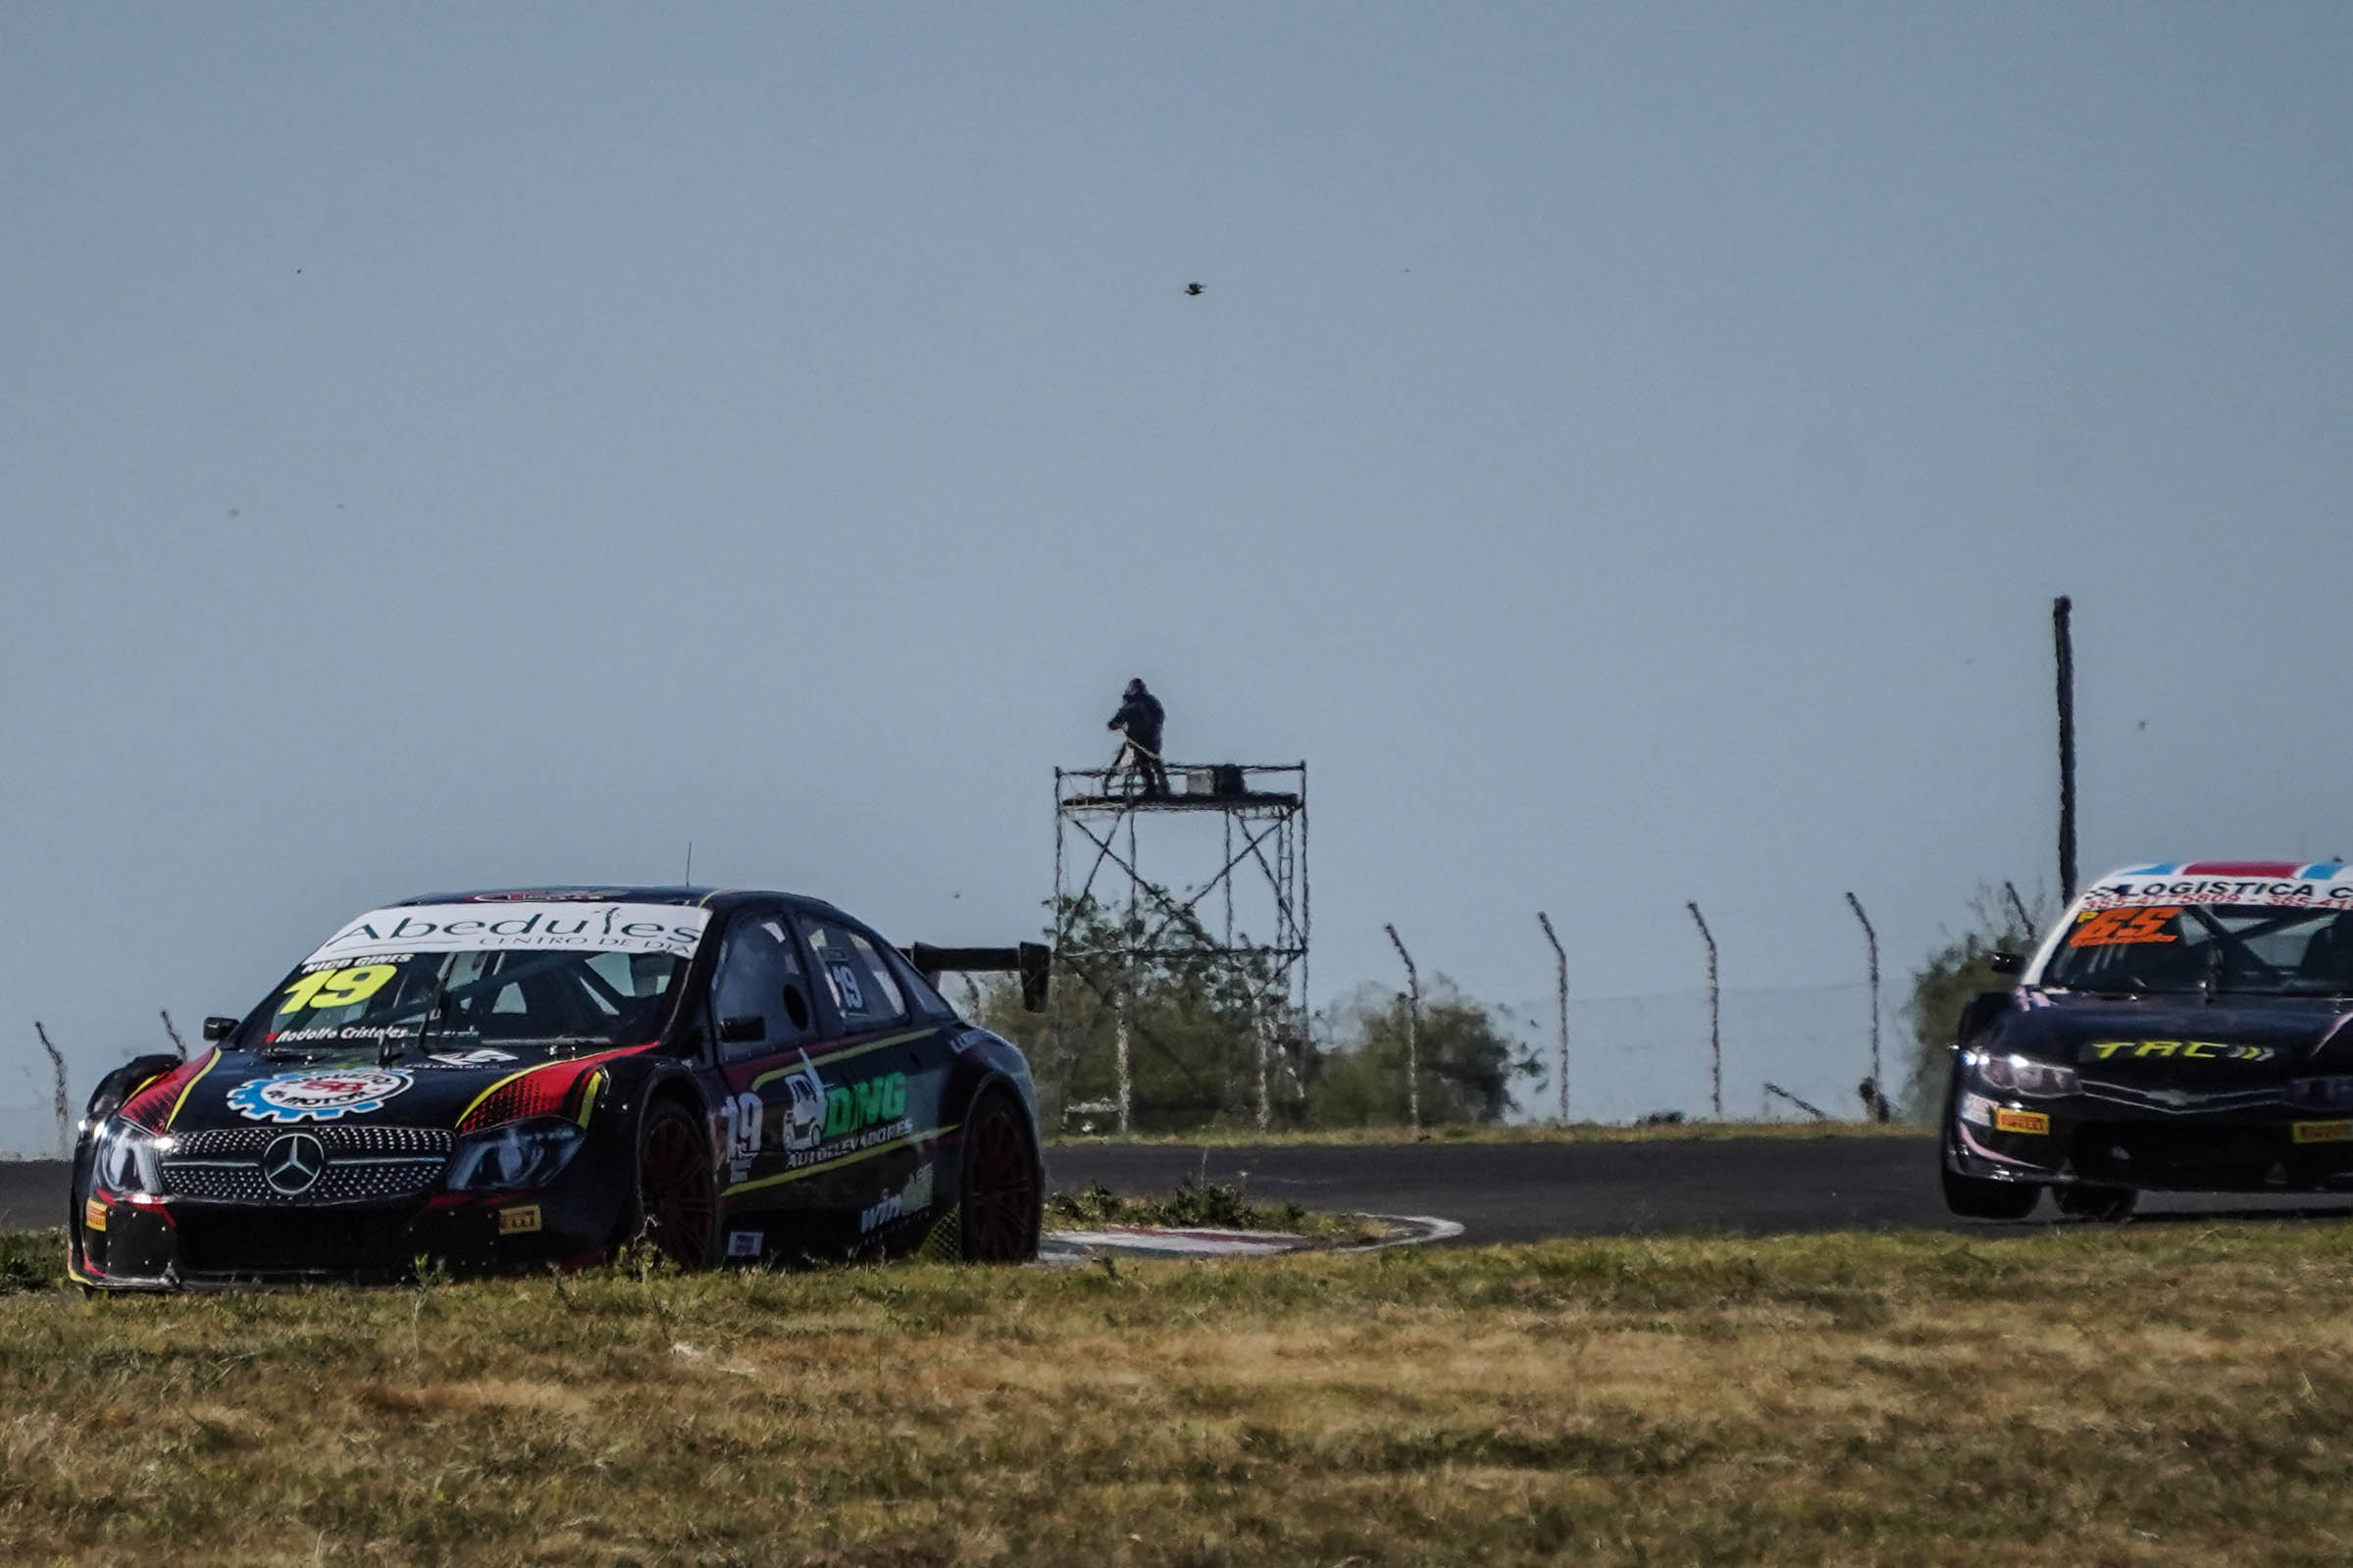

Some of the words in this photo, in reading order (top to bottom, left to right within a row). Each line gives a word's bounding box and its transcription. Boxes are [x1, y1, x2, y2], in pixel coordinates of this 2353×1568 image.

[280, 964, 397, 1015] 19
[275, 1029, 336, 1042] Rodolfo
[721, 1091, 763, 1165] 19
